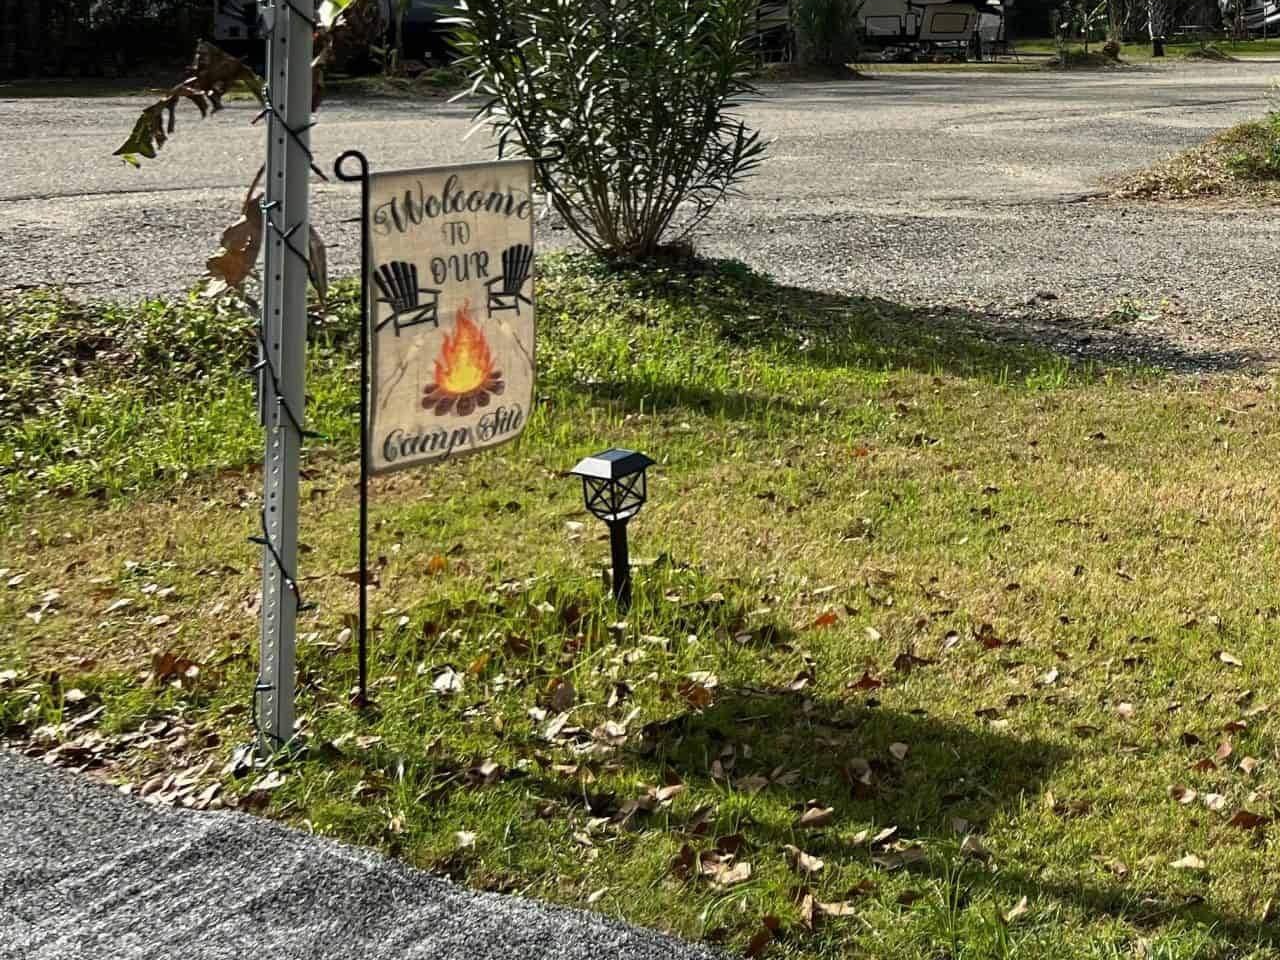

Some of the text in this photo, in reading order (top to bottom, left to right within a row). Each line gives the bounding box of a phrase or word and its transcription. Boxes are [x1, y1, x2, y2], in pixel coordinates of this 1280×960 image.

[373, 174, 533, 235] Welcome
[430, 250, 490, 285] OUR
[383, 427, 474, 461] Camp
